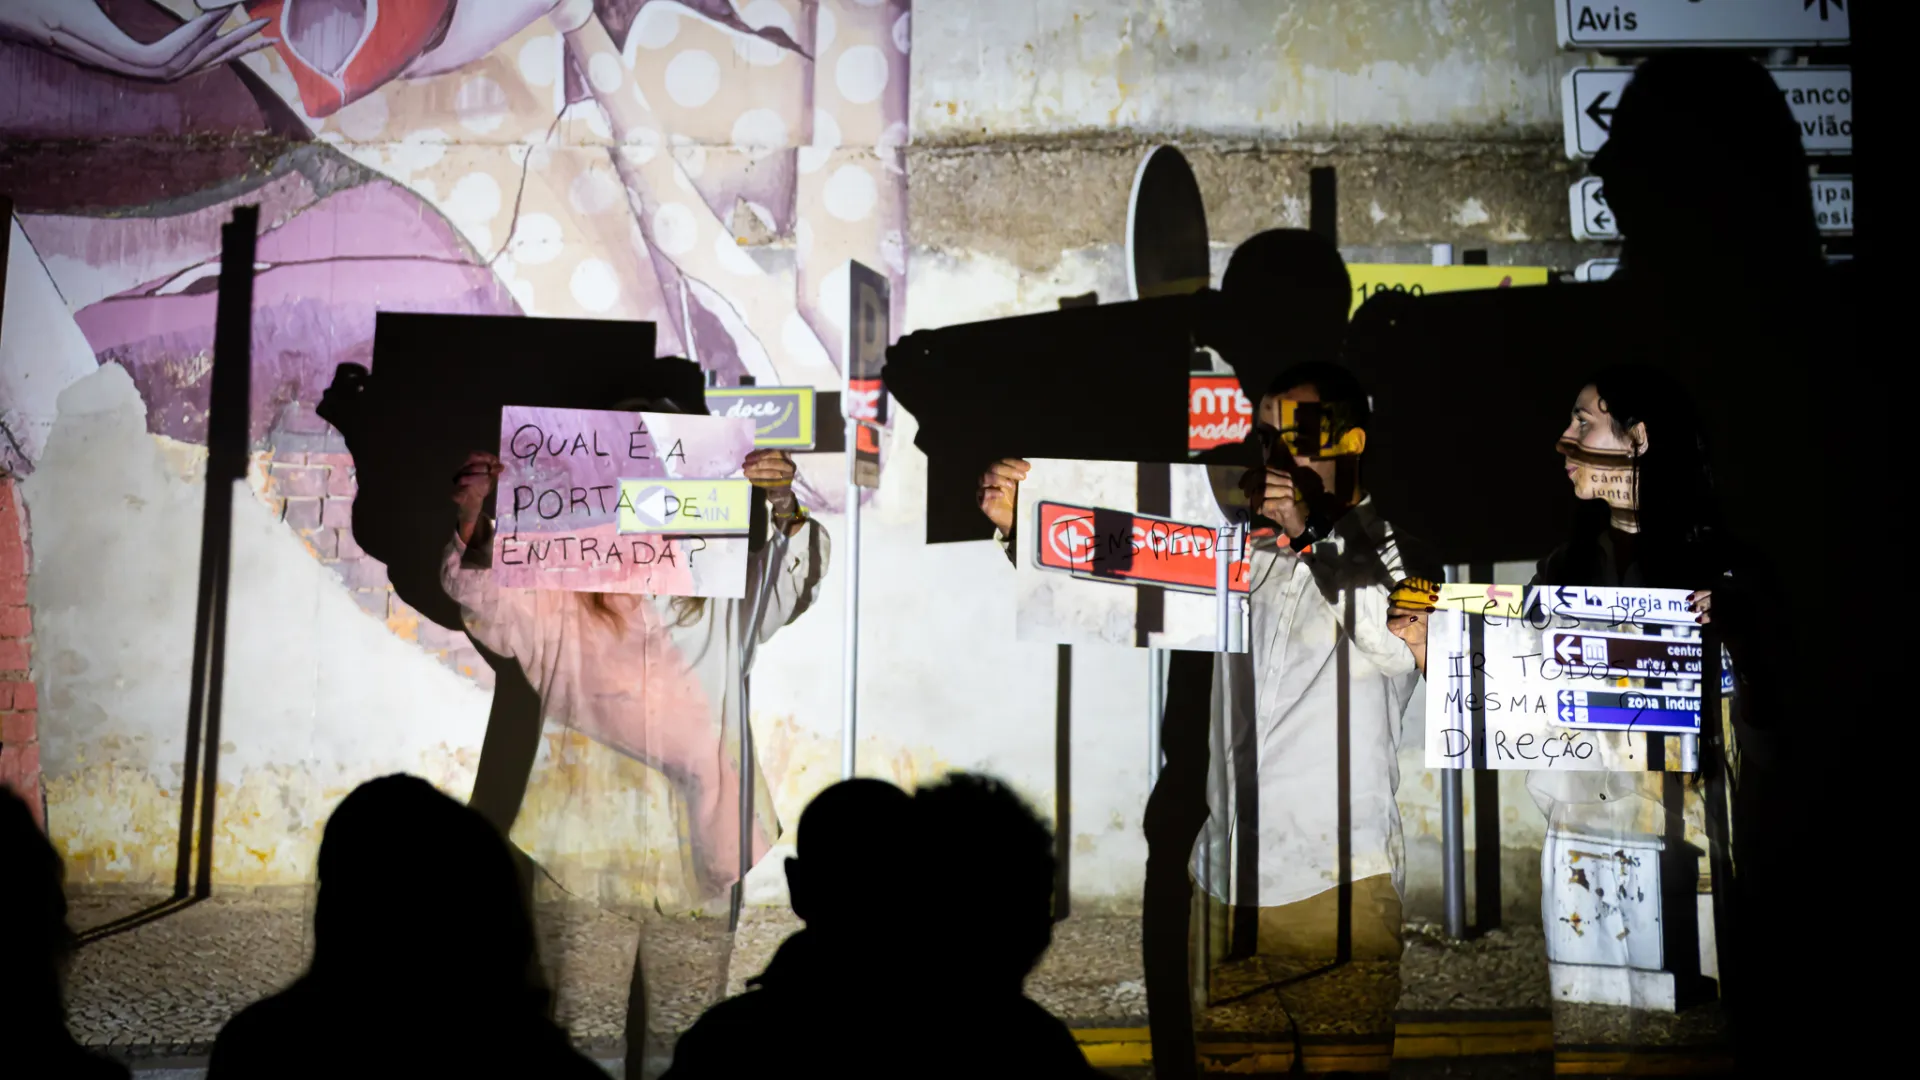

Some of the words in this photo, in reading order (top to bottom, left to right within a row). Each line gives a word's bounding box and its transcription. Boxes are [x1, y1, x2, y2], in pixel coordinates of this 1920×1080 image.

[1577, 6, 1639, 31] Avis
[1799, 115, 1852, 137] vião
[726, 398, 781, 419] doce
[510, 423, 610, 467] QUAL
[629, 421, 650, 460] É
[666, 438, 686, 464] A
[706, 488, 718, 502] 4
[513, 484, 636, 532] PORTA
[664, 495, 699, 518] DE
[695, 503, 731, 522] MIN
[1615, 592, 1662, 613] igreja
[1667, 645, 1702, 657] centro
[1448, 653, 1494, 679] IR
[1512, 653, 1629, 681] TODOS
